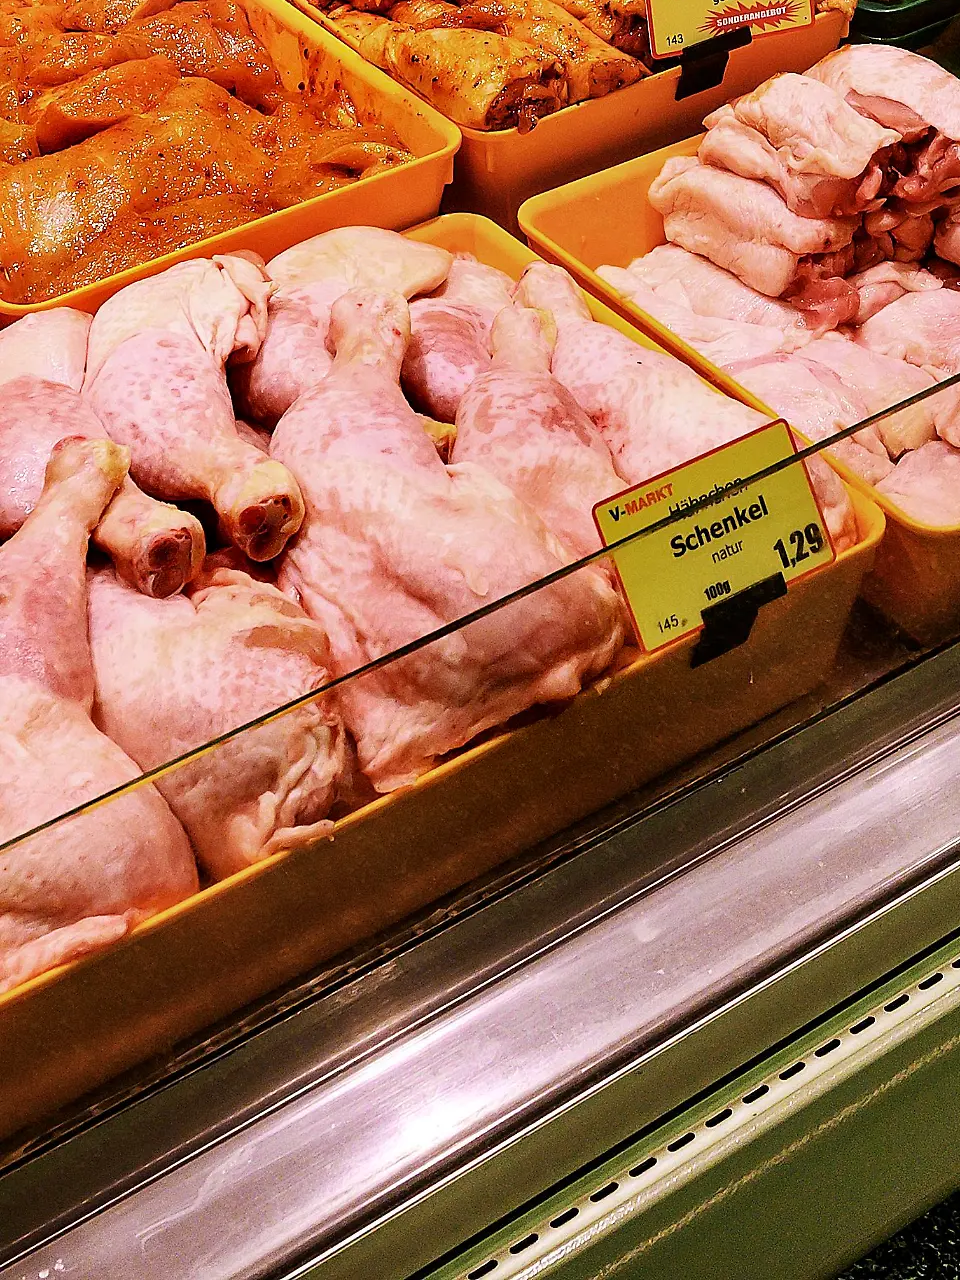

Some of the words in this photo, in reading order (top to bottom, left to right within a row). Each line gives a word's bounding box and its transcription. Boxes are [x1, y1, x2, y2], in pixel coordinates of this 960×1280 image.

[716, 7, 787, 27] SONDERANGEBOT
[666, 34, 684, 46] 143
[608, 483, 673, 522] V-MARKT
[670, 495, 769, 558] Schenkel
[712, 539, 744, 564] natur
[773, 522, 824, 569] 1,29
[704, 580, 732, 601] 100g
[657, 614, 679, 633] 145
